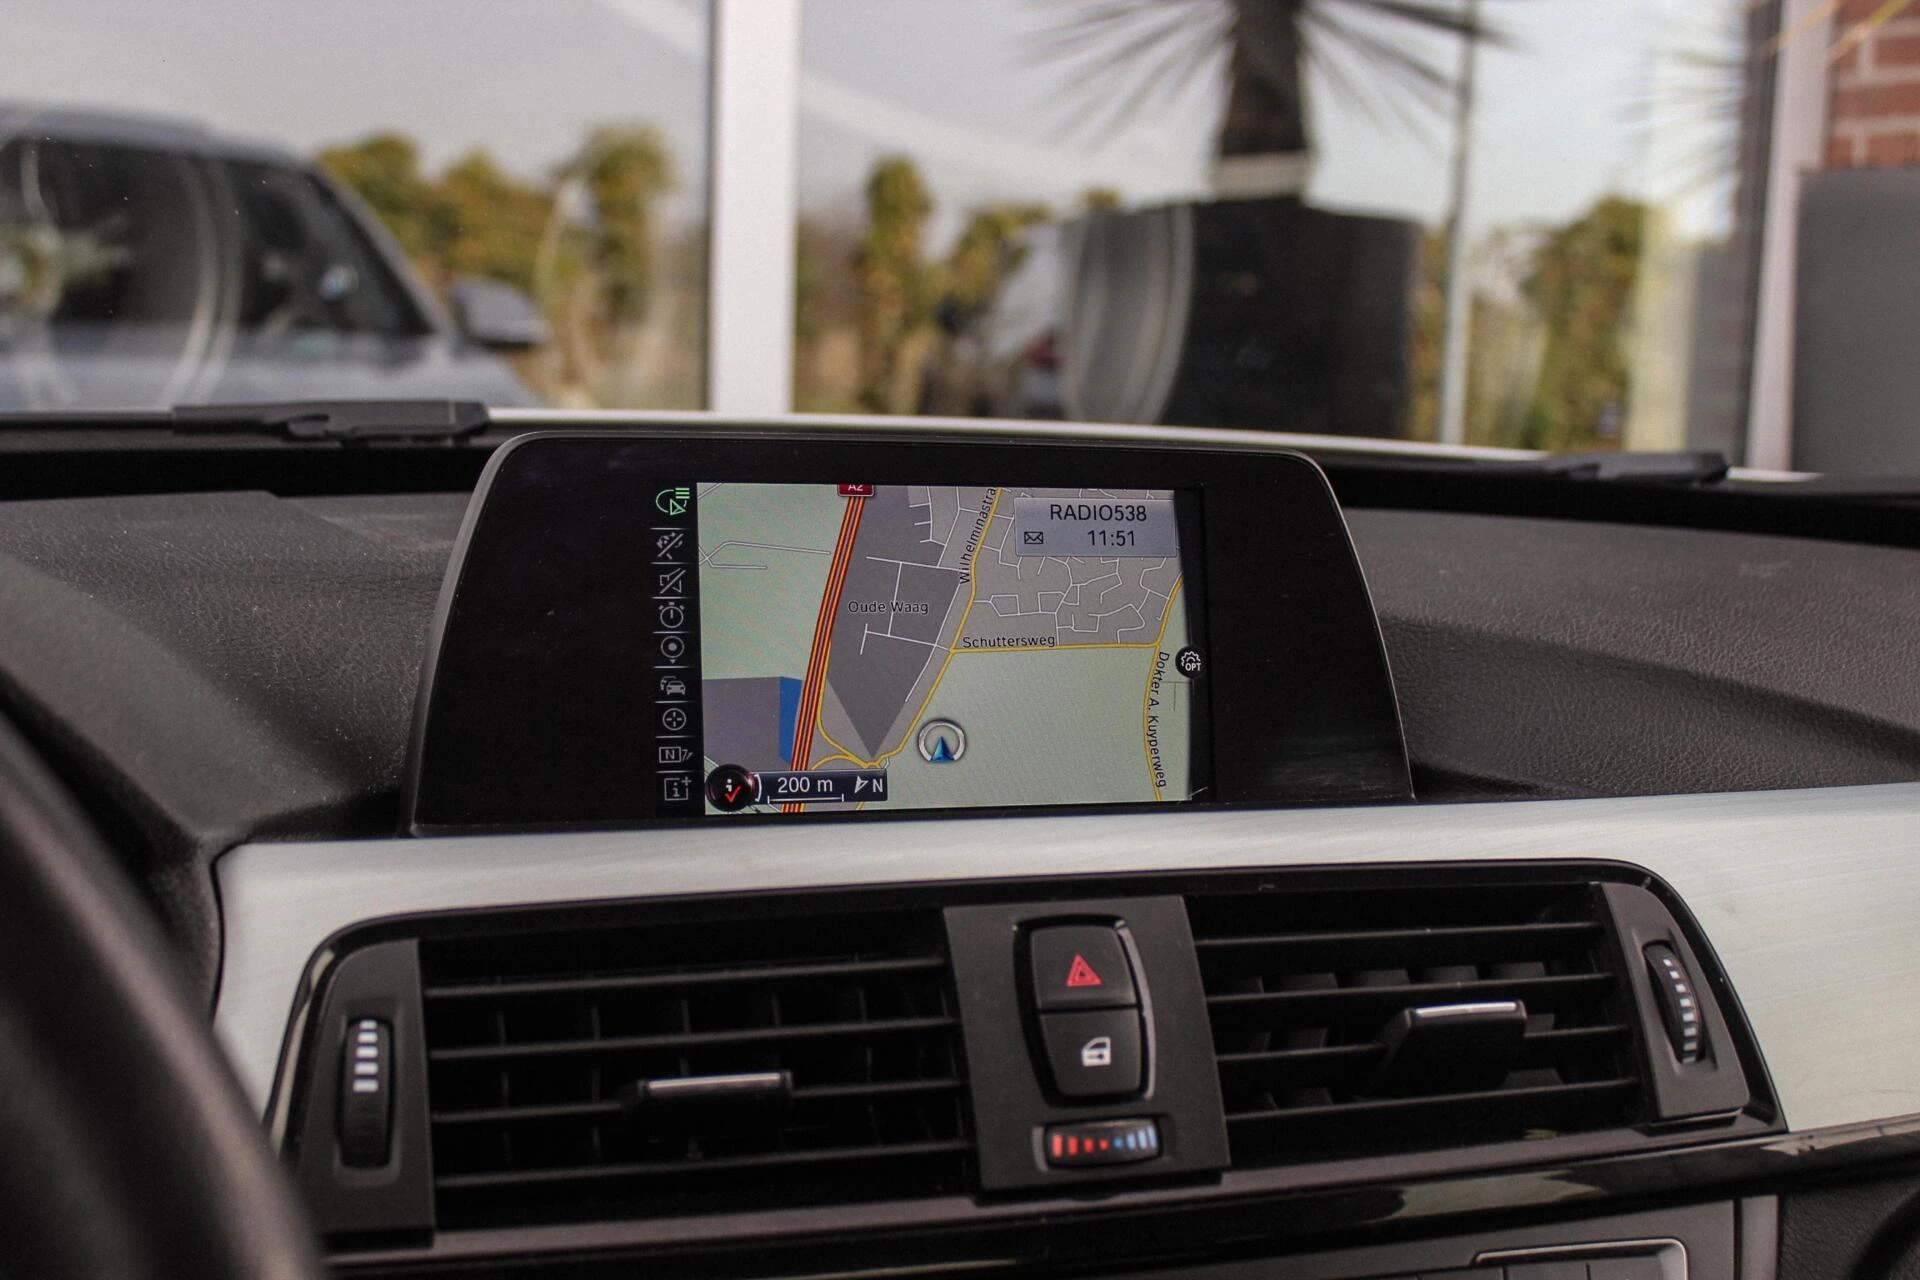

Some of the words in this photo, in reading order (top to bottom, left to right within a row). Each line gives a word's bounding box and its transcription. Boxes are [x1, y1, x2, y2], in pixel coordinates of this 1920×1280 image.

[1050, 504, 1148, 522] RADIO538
[959, 487, 996, 584] Wilhelminastra
[1088, 529, 1136, 547] 11:51
[848, 601, 886, 613] Oude
[890, 601, 930, 615] Waag
[962, 636, 1055, 648] Schuttersweg
[1151, 651, 1169, 694] Dokter
[1184, 662, 1202, 672] OPT
[1147, 714, 1167, 788] Kuyperweg
[777, 778, 811, 794] 200
[816, 781, 833, 793] m
